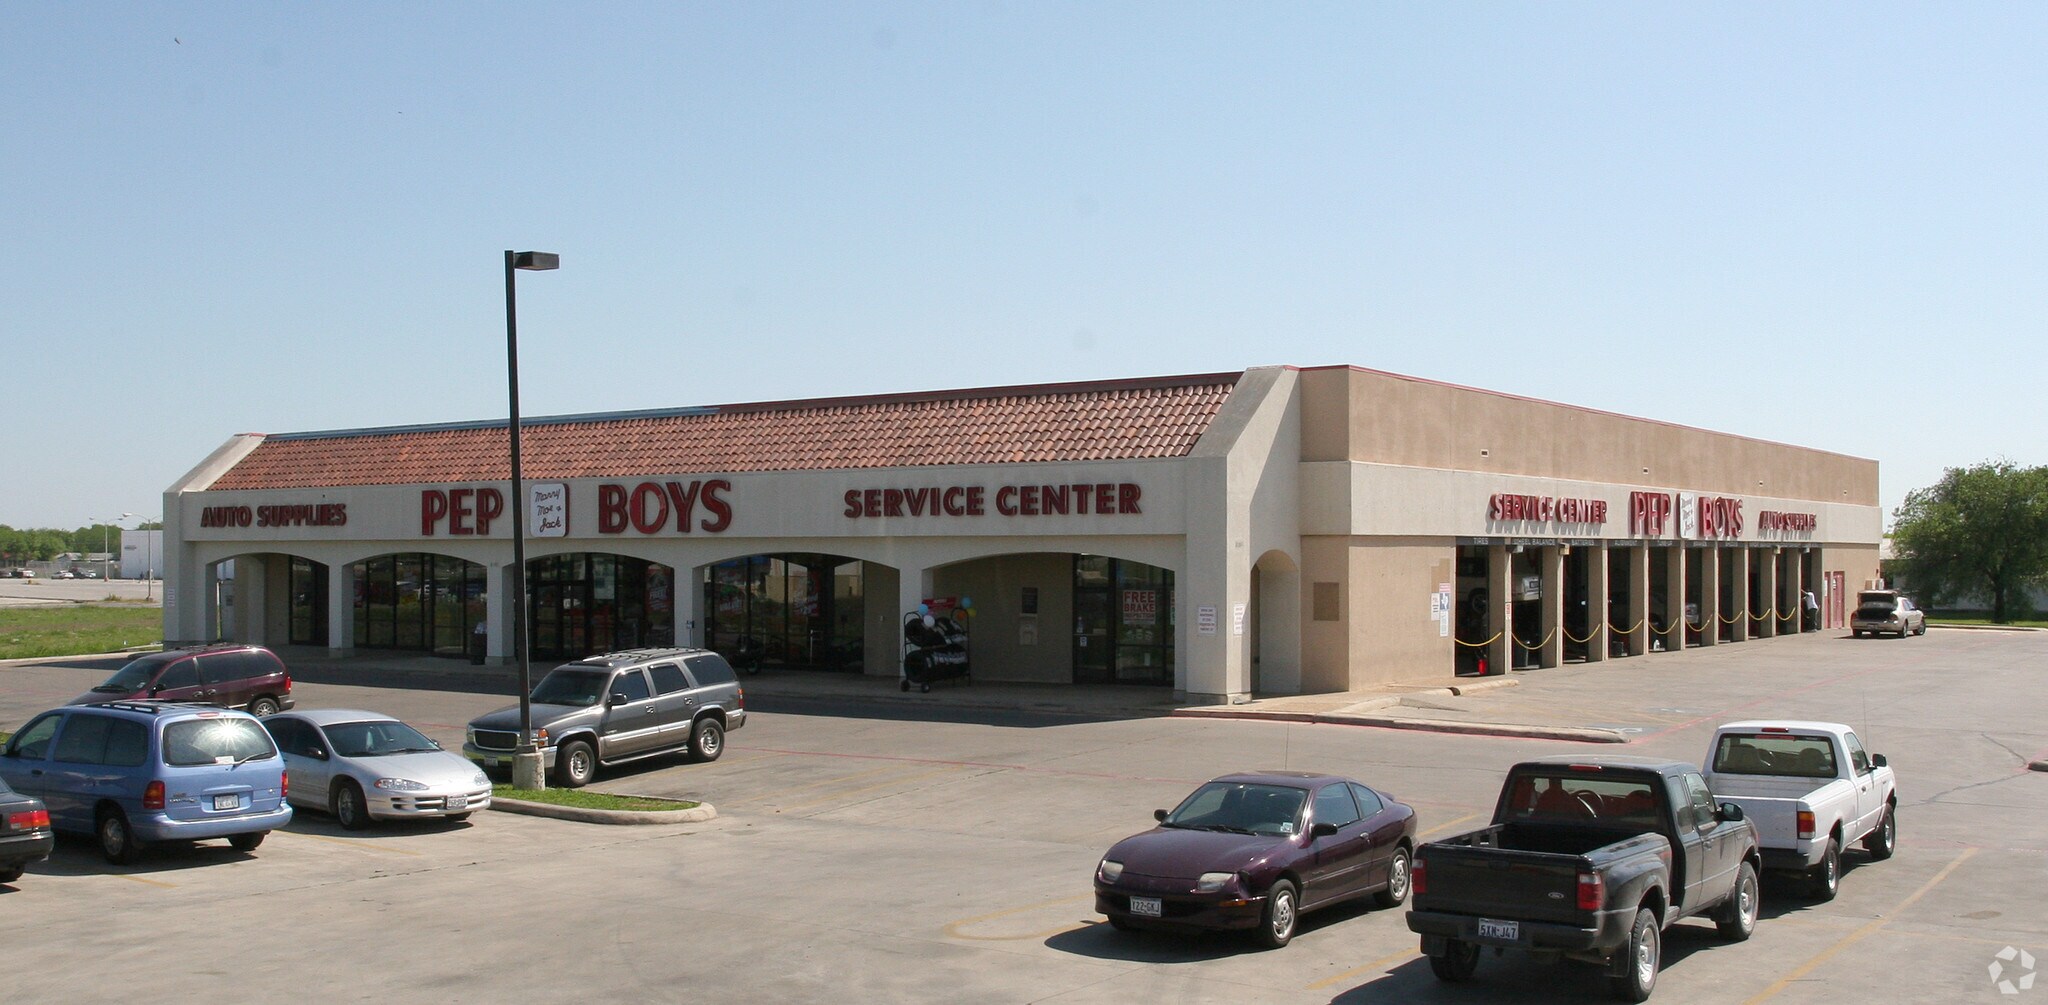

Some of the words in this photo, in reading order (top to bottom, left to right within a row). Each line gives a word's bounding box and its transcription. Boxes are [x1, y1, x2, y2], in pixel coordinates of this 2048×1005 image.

[422, 488, 504, 536] PEP
[598, 479, 733, 535] BOYS
[844, 486, 985, 518] SERVICE
[996, 483, 1142, 517] CENTER
[1490, 494, 1553, 521] SERVICE
[1555, 497, 1607, 523] CENTER
[200, 505, 252, 528] AUTO
[257, 503, 348, 528] SUPPLIES
[539, 516, 562, 533] Jack
[1631, 491, 1671, 536] PEP
[1699, 496, 1744, 538] BOYS
[1759, 511, 1782, 530] AUTO
[1782, 512, 1817, 531] SUPPLIES
[1124, 591, 1155, 603] FREE
[1124, 603, 1155, 613] BRAKE
